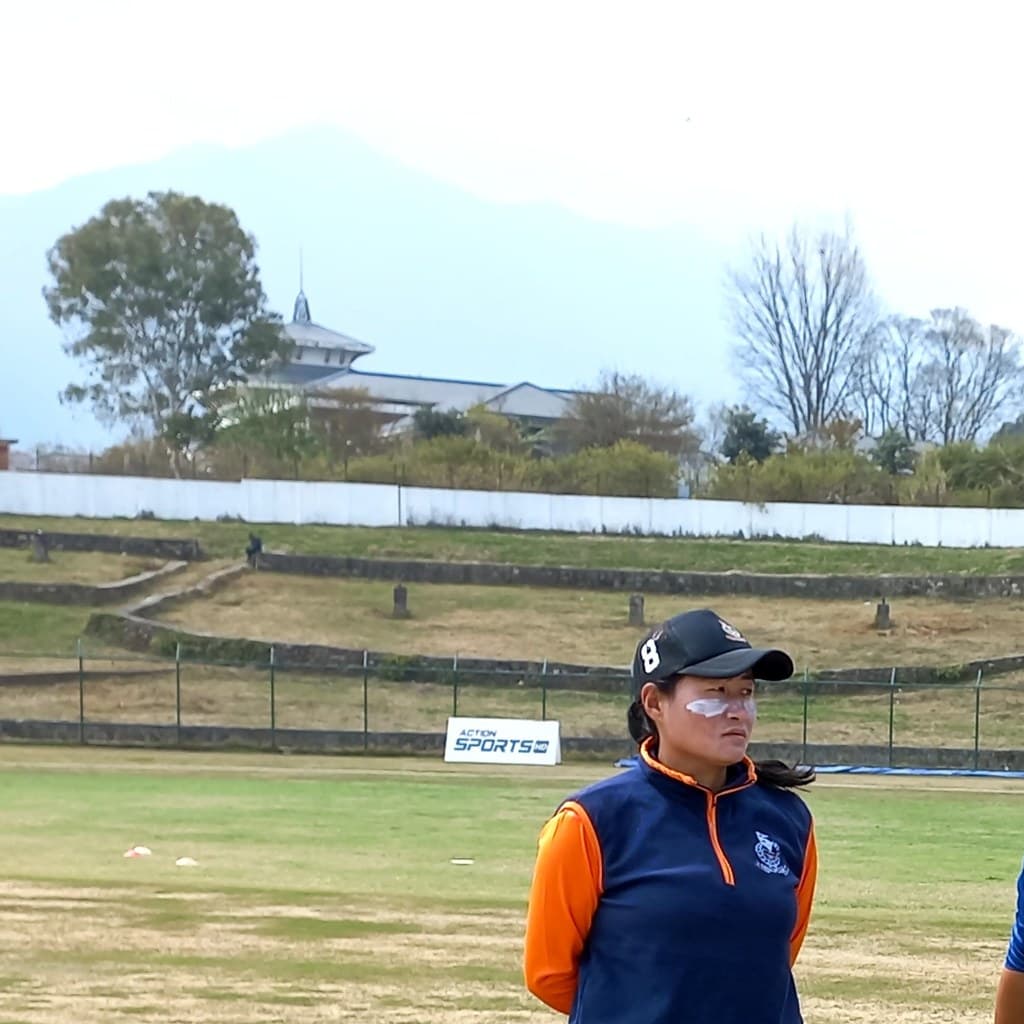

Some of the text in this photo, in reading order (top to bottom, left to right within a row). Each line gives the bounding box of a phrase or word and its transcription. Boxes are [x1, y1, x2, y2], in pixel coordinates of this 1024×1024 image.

[641, 638, 660, 674] 8
[459, 729, 498, 737] ACTION
[454, 738, 534, 753] SPORTS
